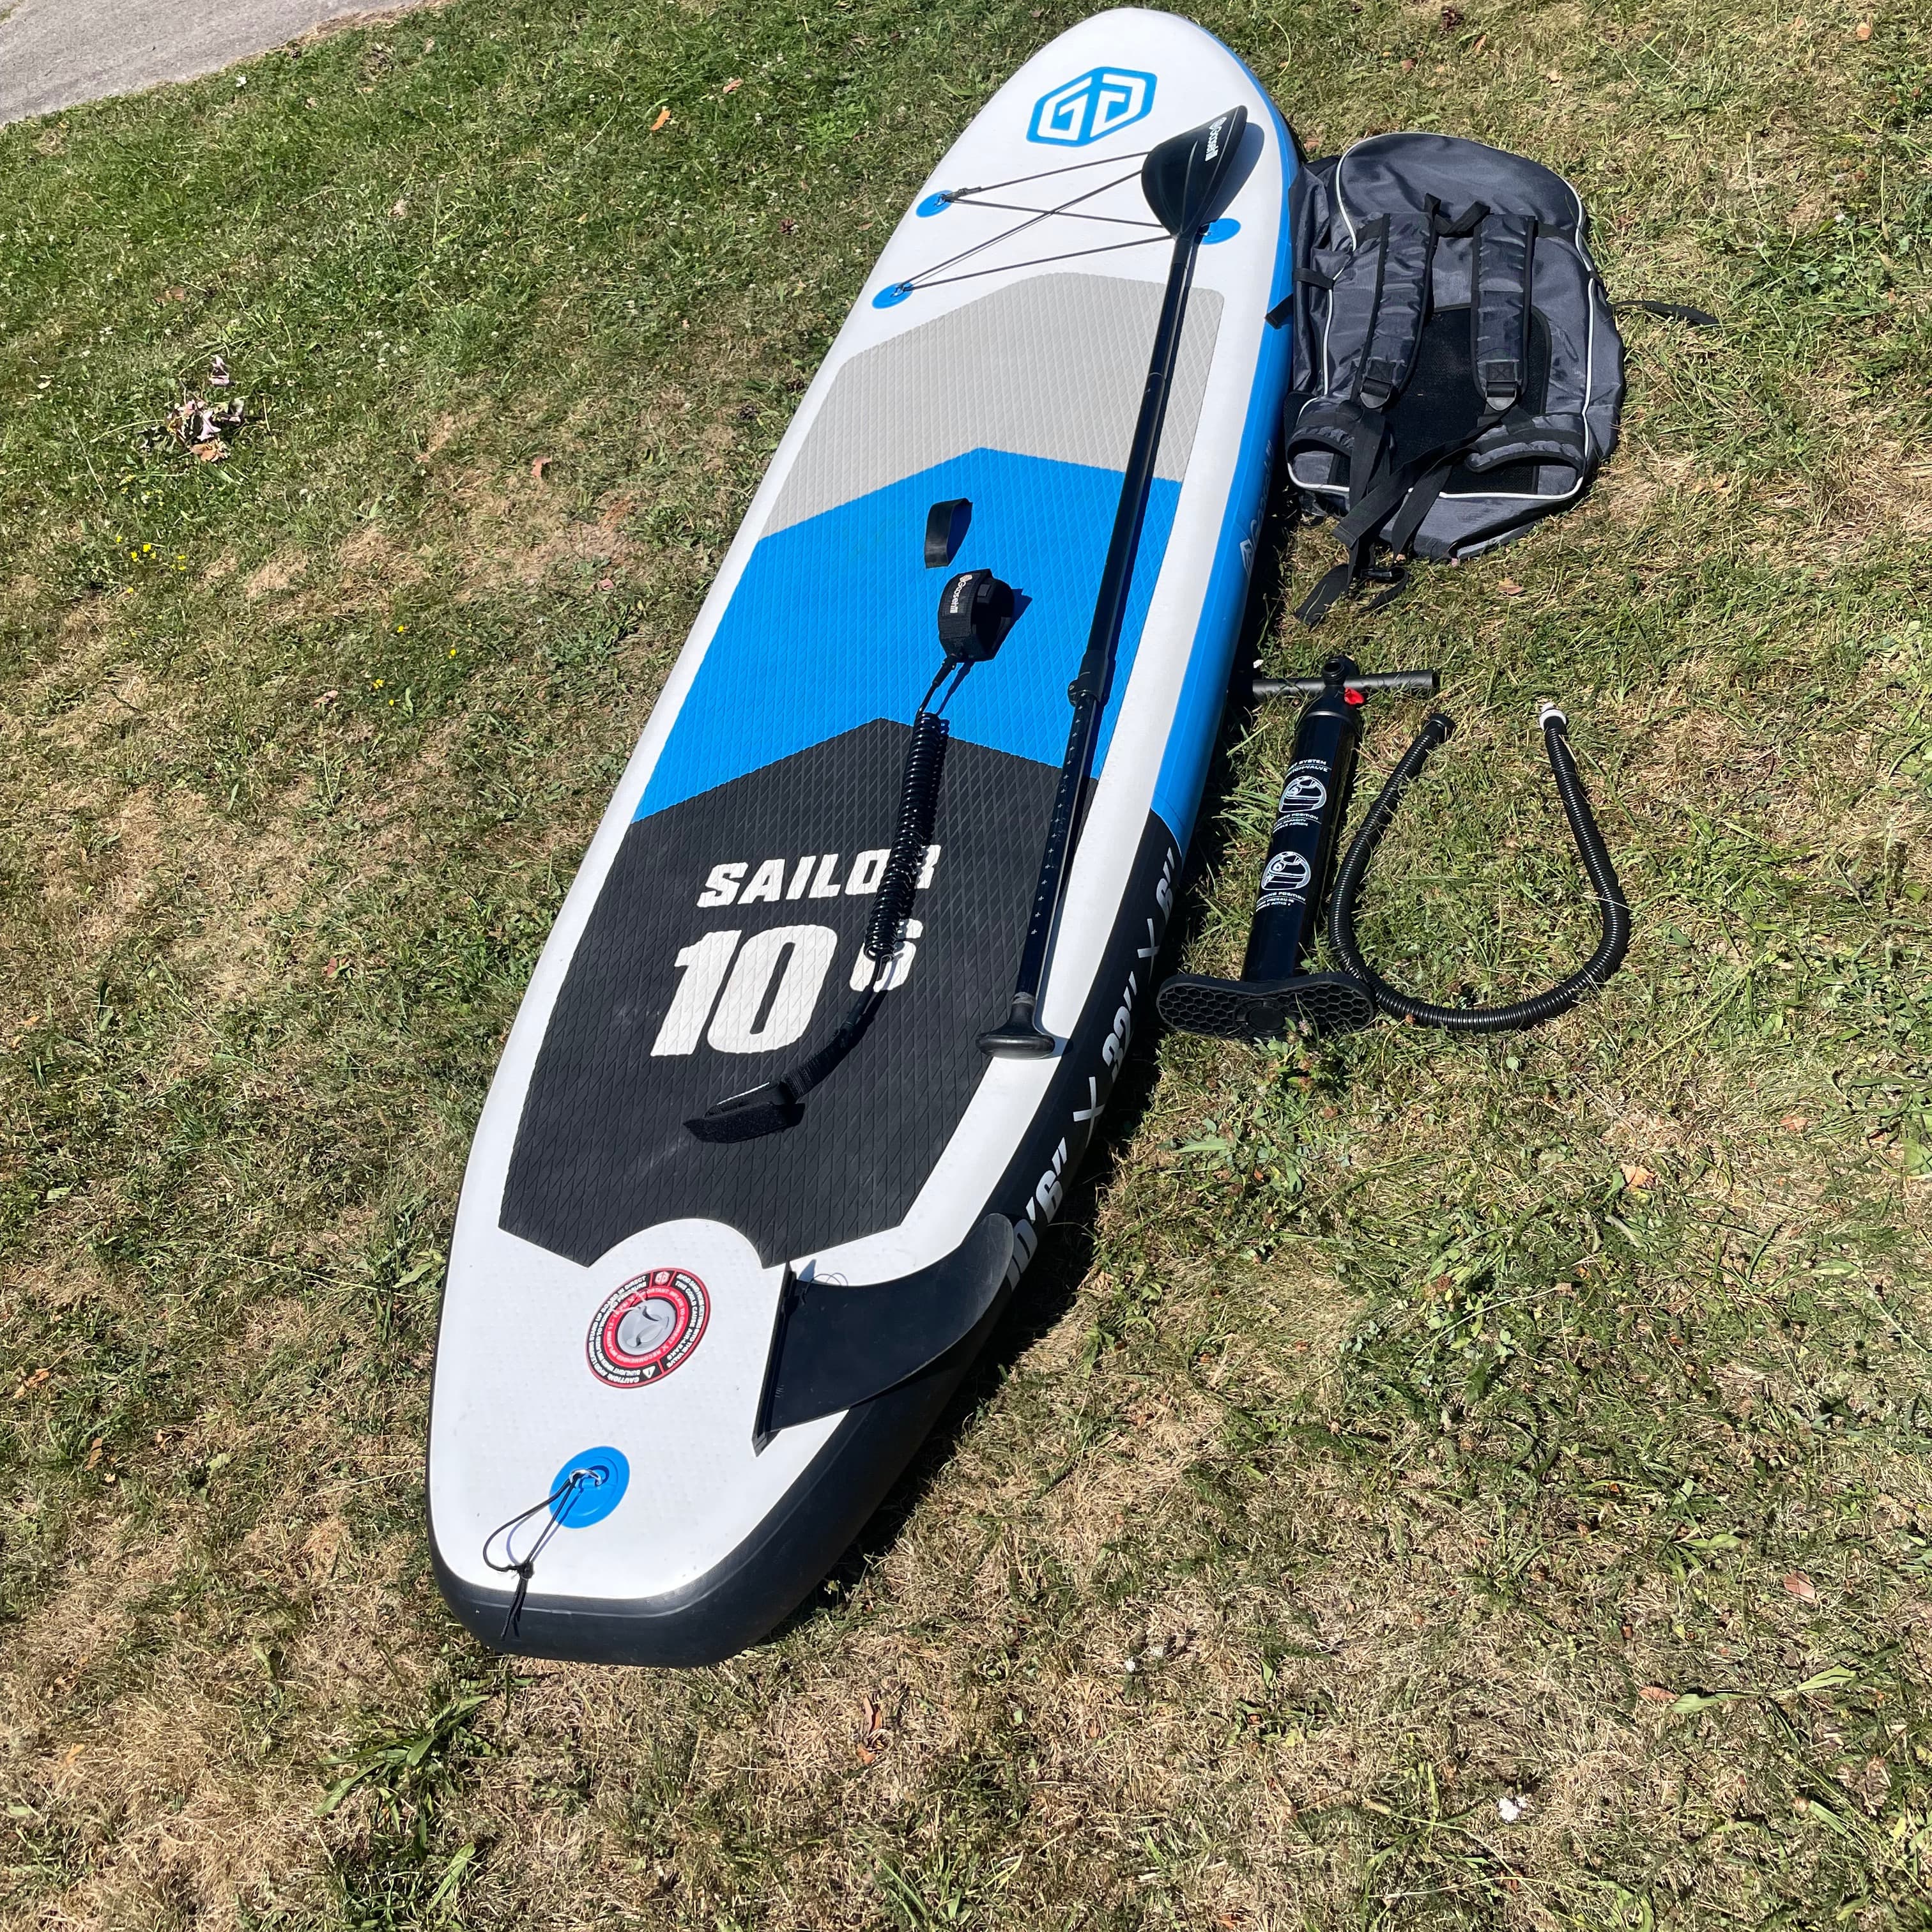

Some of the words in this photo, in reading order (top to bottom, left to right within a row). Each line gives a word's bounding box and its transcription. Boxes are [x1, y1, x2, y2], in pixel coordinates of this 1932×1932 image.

[949, 581, 967, 613] Goosehill
[650, 924, 838, 1057] 10
[624, 1275, 647, 1289] DIRECT
[685, 1288, 697, 1307] COULD
[595, 1312, 602, 1321] UP
[689, 1307, 698, 1328] CAUSE
[666, 1351, 685, 1368] VALVE
[594, 1363, 608, 1376] AVOID
